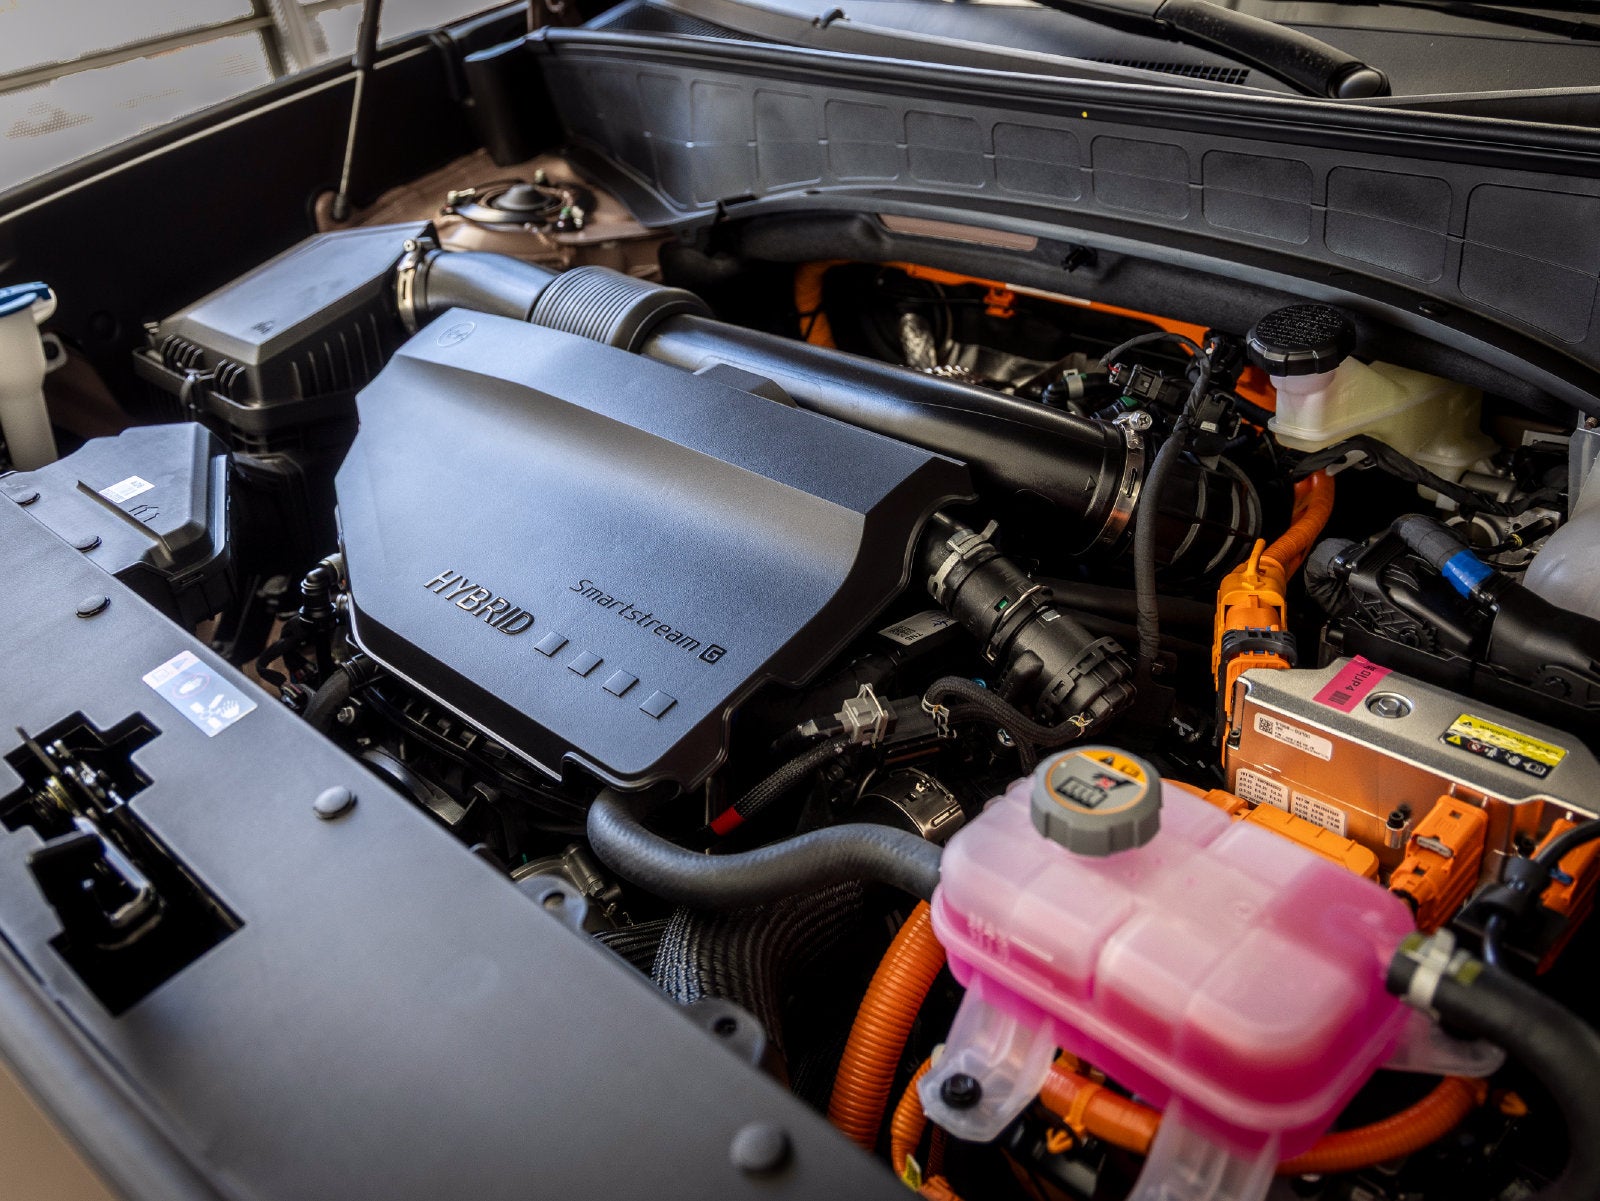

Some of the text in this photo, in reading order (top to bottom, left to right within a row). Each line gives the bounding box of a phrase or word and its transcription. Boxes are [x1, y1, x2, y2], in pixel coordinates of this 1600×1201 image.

[423, 568, 536, 635] HYBRID
[569, 579, 727, 664] Smartstream G
